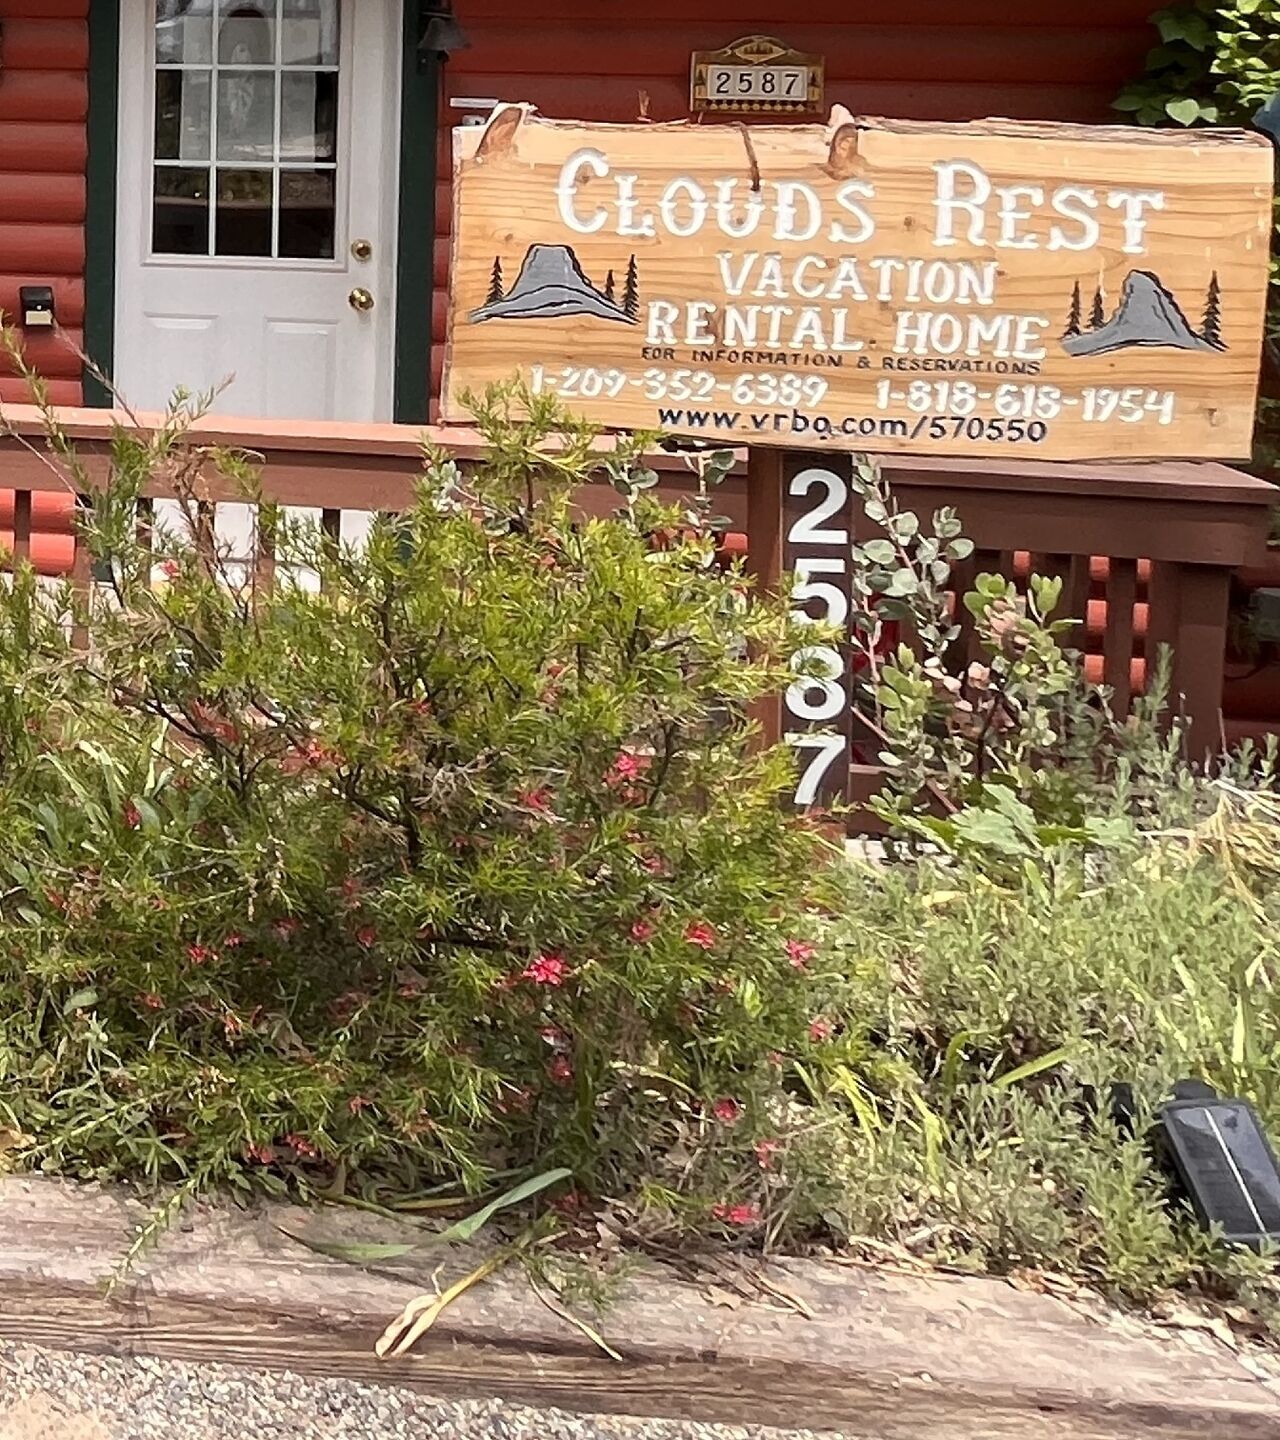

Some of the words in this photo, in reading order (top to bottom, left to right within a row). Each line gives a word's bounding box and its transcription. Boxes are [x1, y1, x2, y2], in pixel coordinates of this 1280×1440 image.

[716, 72, 799, 94] 2587
[554, 148, 876, 243] CLOUDS
[931, 158, 1165, 253] REST
[715, 250, 999, 305] VACATION
[644, 300, 865, 351] RENTAL
[892, 310, 1050, 360] HOME
[641, 346, 676, 360] FOR
[692, 348, 843, 368] INFORMATION
[856, 356, 872, 370] &
[882, 357, 1042, 376] RESERVATIONS
[530, 364, 830, 408] 1-209-352-6389
[876, 379, 1176, 425] 1-818-618-1954
[659, 408, 1048, 442] www.vrbo.com/570550
[784, 467, 849, 806] 2587
